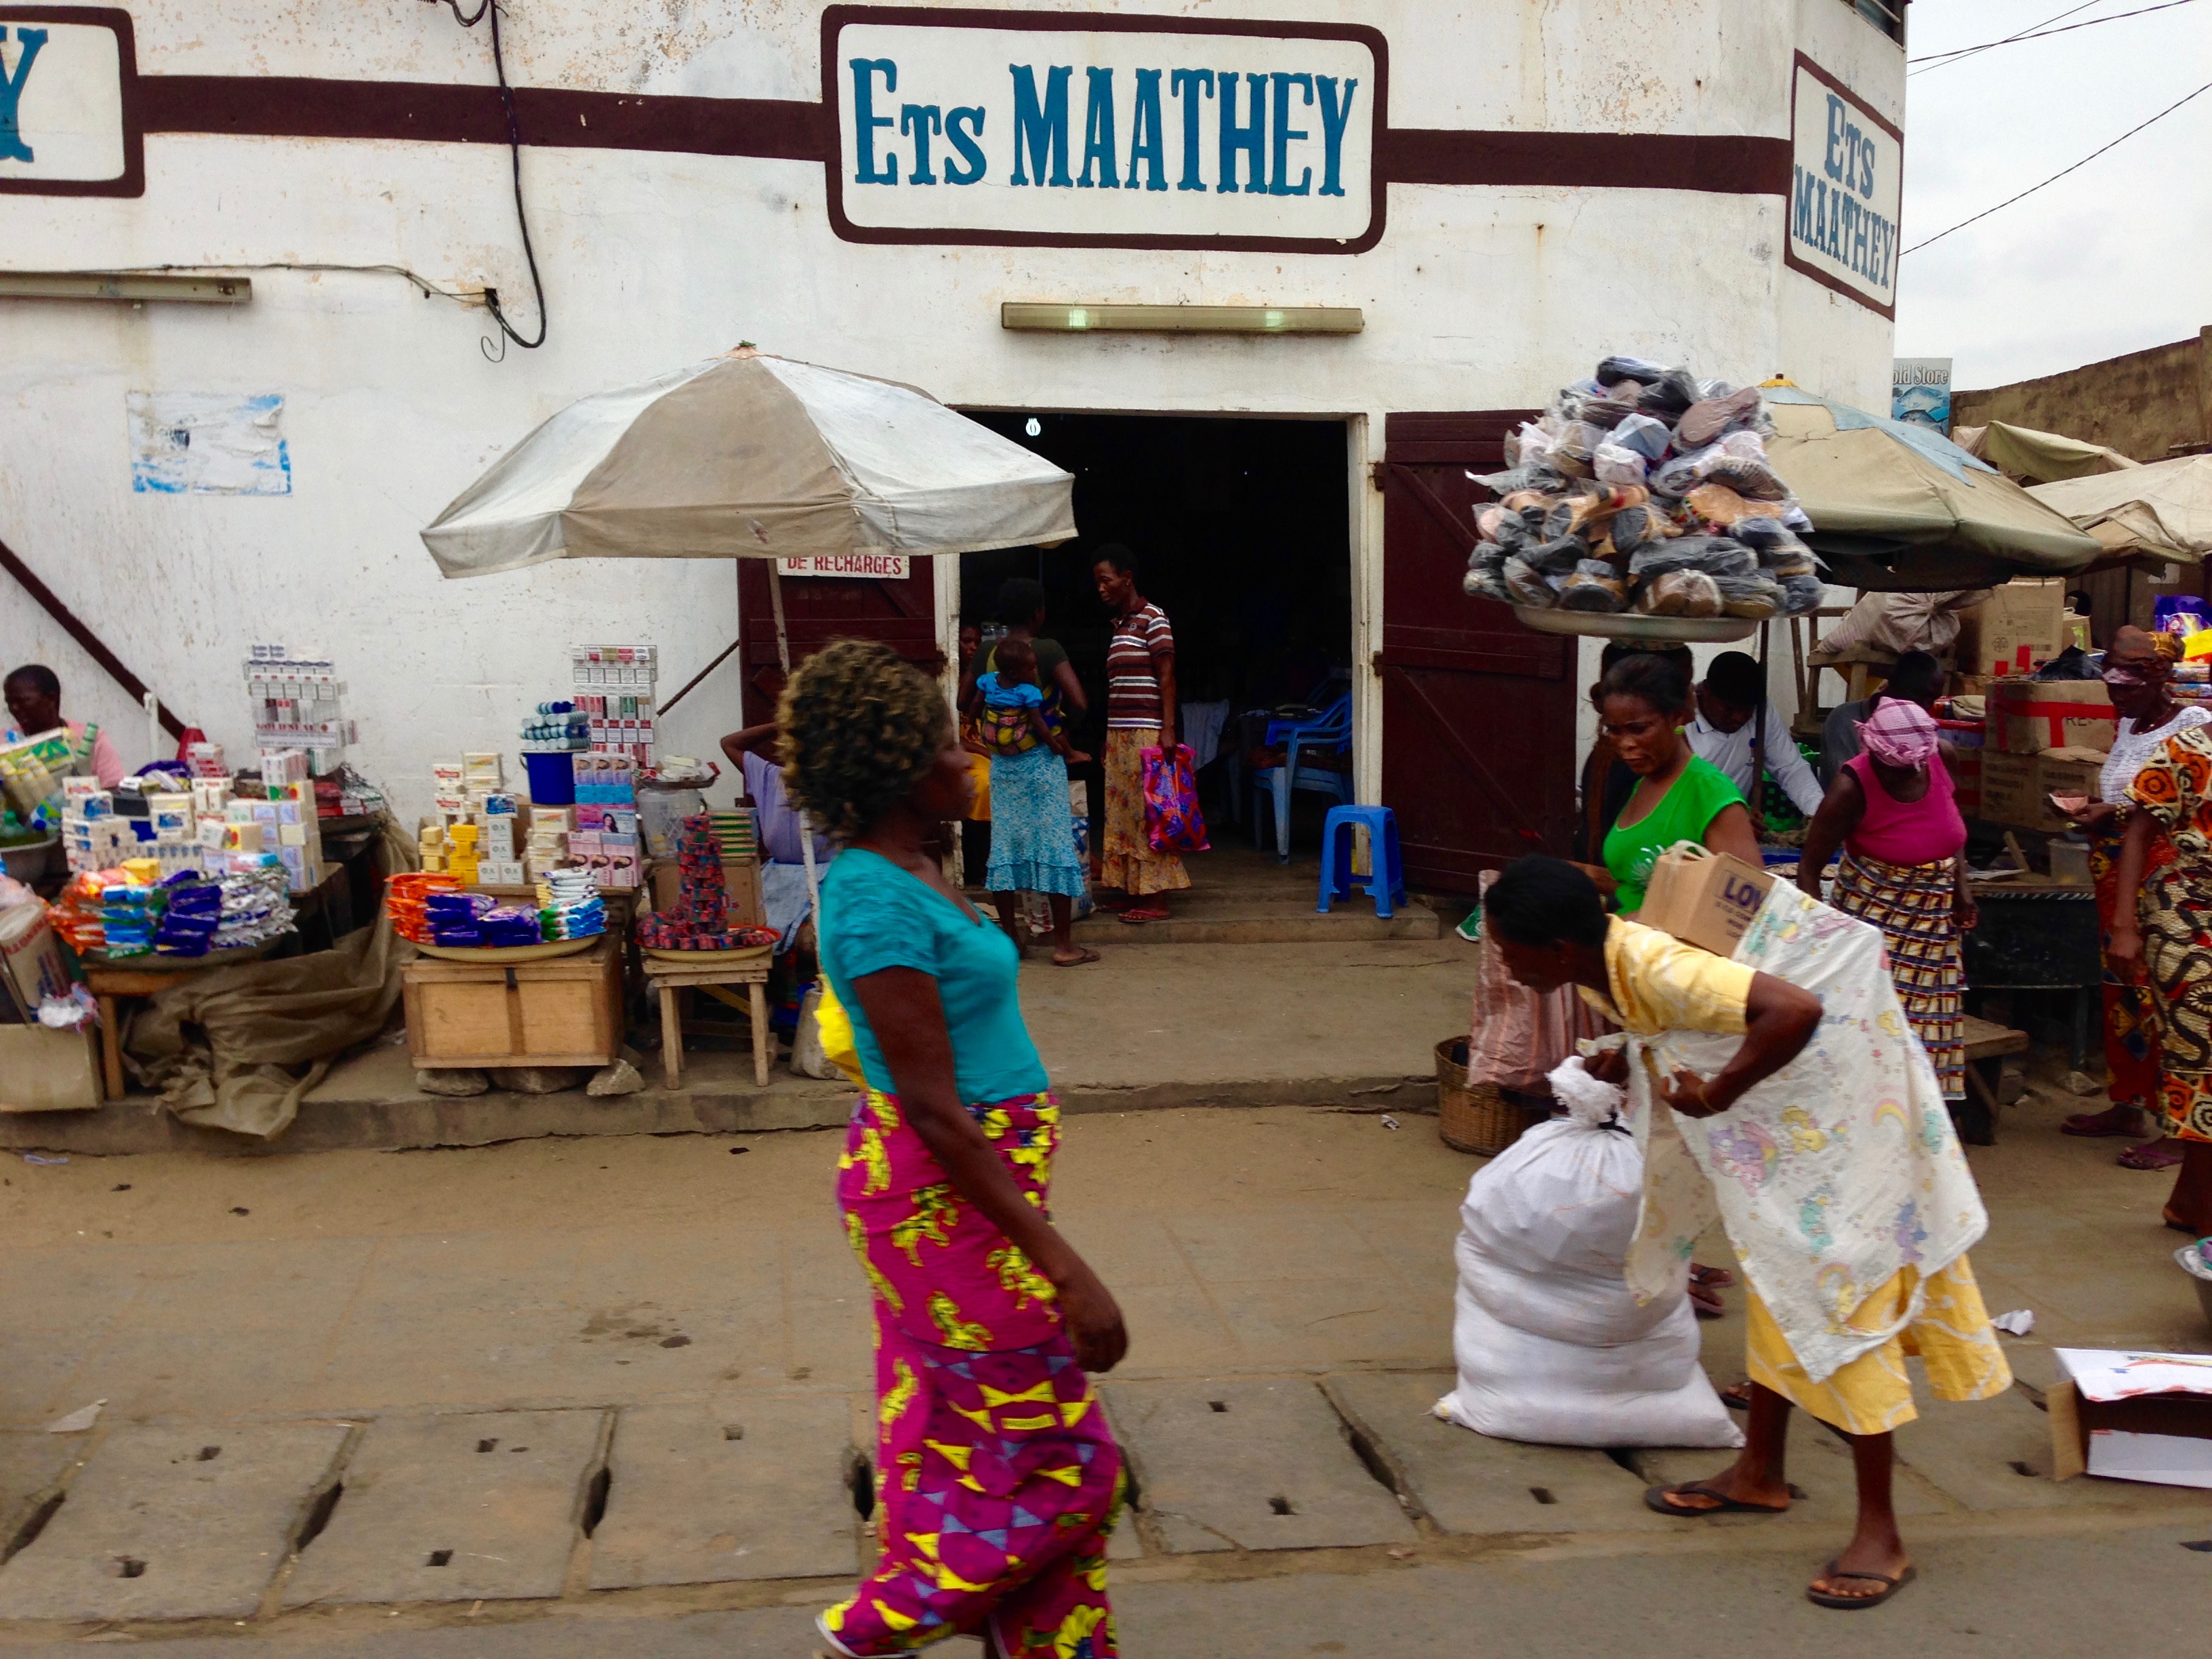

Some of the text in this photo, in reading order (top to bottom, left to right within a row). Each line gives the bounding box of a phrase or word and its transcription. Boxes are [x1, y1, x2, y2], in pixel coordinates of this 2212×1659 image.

[1009, 64, 1358, 197] MAATHEY
[1824, 92, 1876, 200] ETS
[1793, 163, 1896, 290] MAATHEY
[1913, 364, 1949, 385] Store
[787, 554, 903, 575] DE RECHARGES
